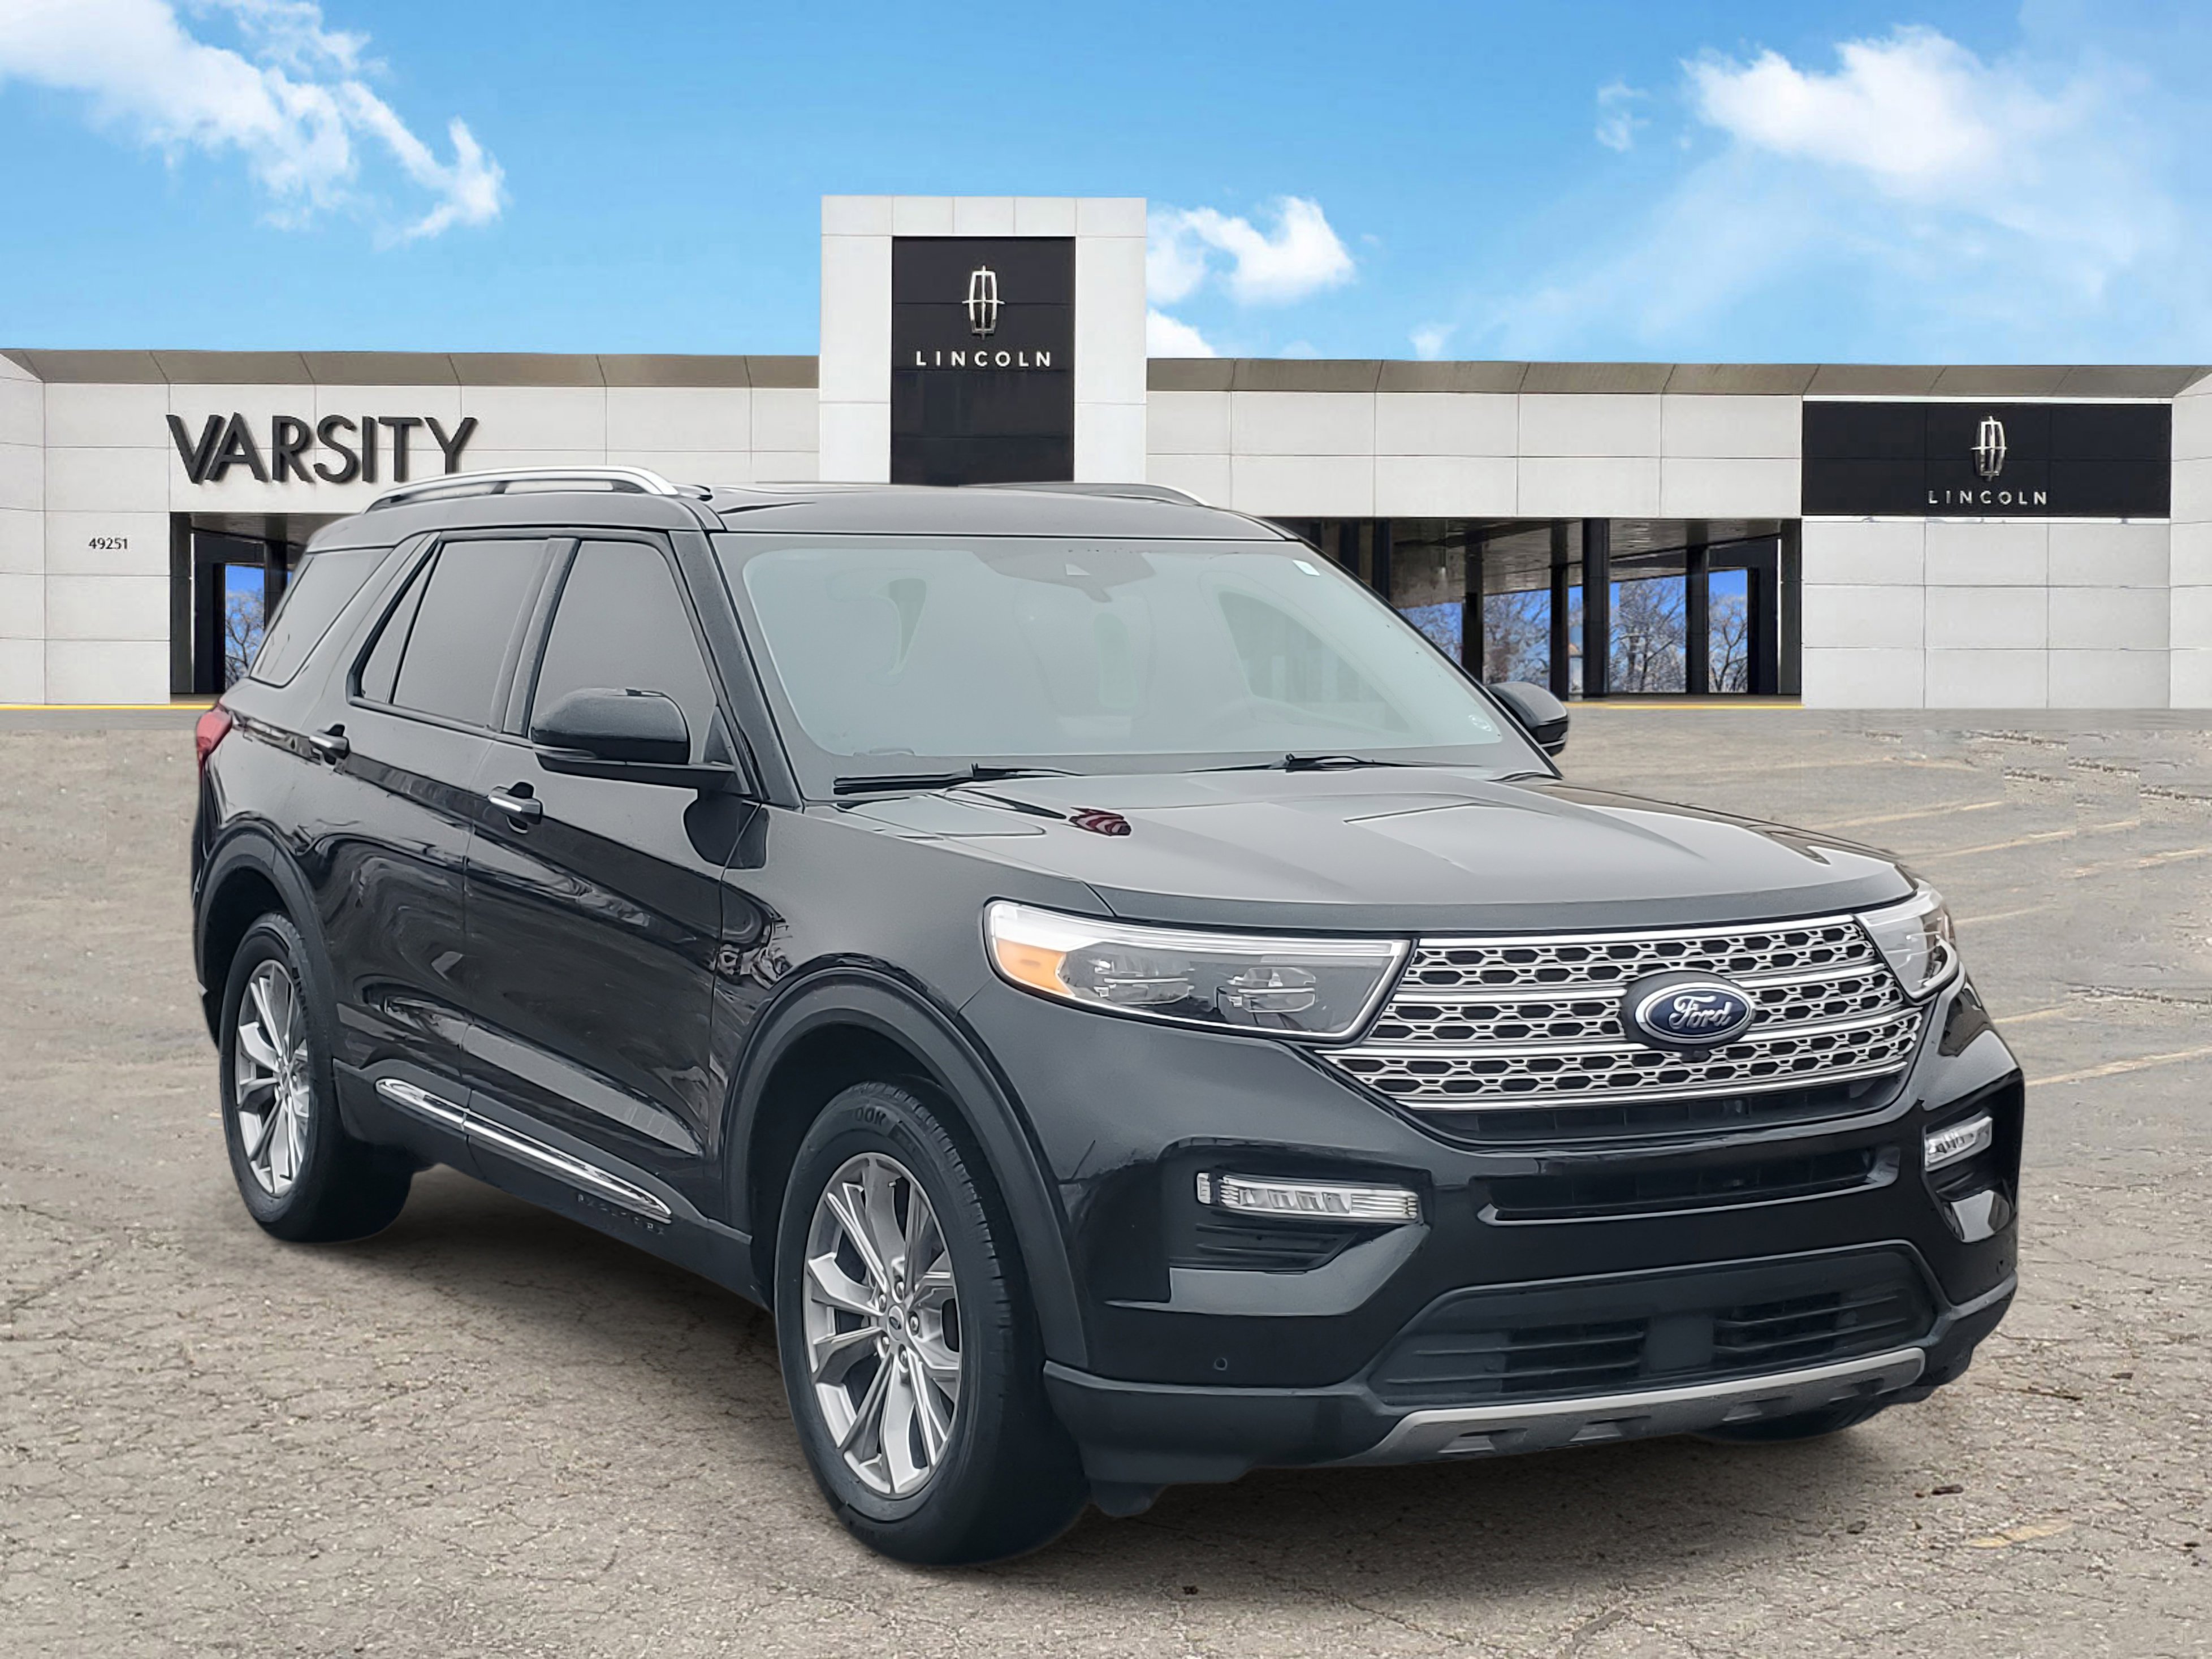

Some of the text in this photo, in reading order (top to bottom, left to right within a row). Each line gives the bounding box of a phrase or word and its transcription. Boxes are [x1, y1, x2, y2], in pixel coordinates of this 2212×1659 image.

[915, 350, 1051, 367] LINCOLN
[166, 412, 478, 485] VARSITY
[1928, 490, 2047, 506] LINCOLN
[88, 537, 128, 550] 49251
[1669, 995, 1733, 1030] Ford
